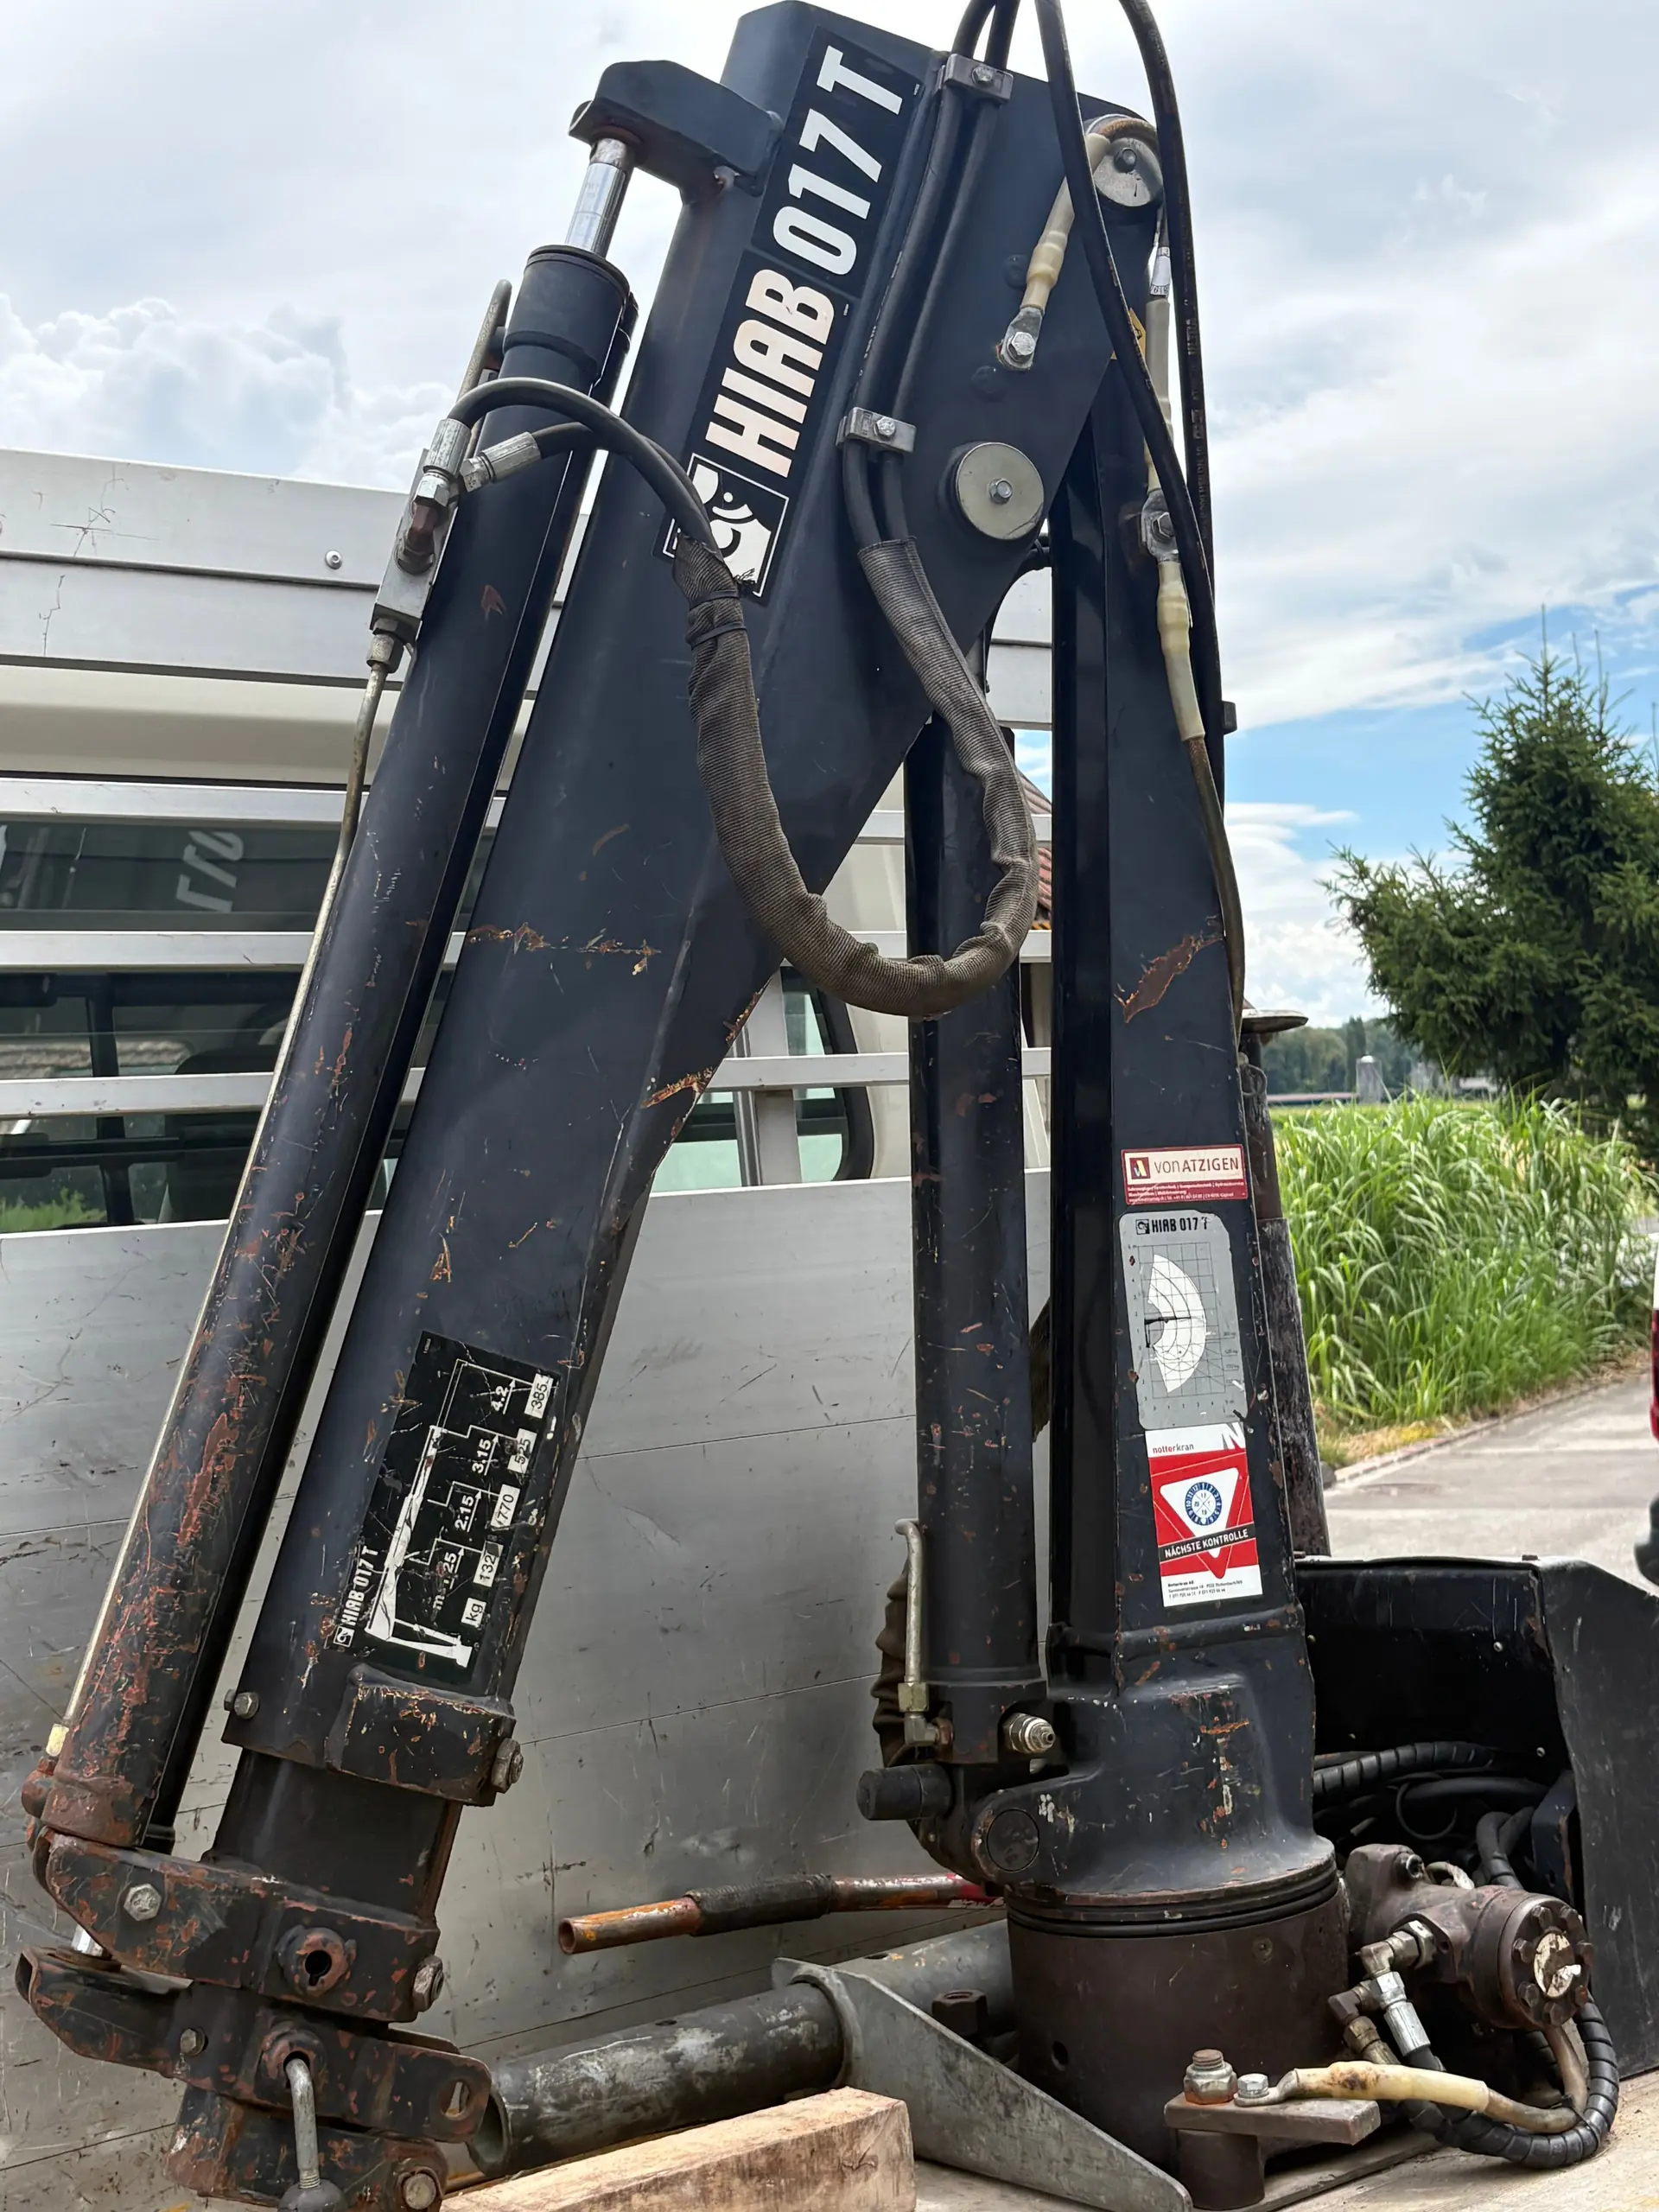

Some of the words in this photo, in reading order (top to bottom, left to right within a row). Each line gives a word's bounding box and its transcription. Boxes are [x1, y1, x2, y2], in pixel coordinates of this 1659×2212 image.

[816, 45, 903, 115] T
[772, 108, 883, 276] 017
[705, 268, 835, 478] HIAB
[1152, 1218, 1177, 1234] HIAB
[1179, 1217, 1199, 1231] 017
[492, 1385, 508, 1411] 4.2
[531, 1382, 548, 1410] 385
[472, 1438, 492, 1474] 3.15
[1153, 1443, 1195, 1454] notterkran
[454, 1495, 474, 1531] 2.15
[361, 1545, 378, 1556] T
[1164, 1541, 1202, 1558] NÄCHSTE
[1203, 1529, 1249, 1548] KONTROLLE
[353, 1558, 374, 1587] 017
[340, 1590, 365, 1626] HIAB
[465, 1603, 484, 1622] kg
